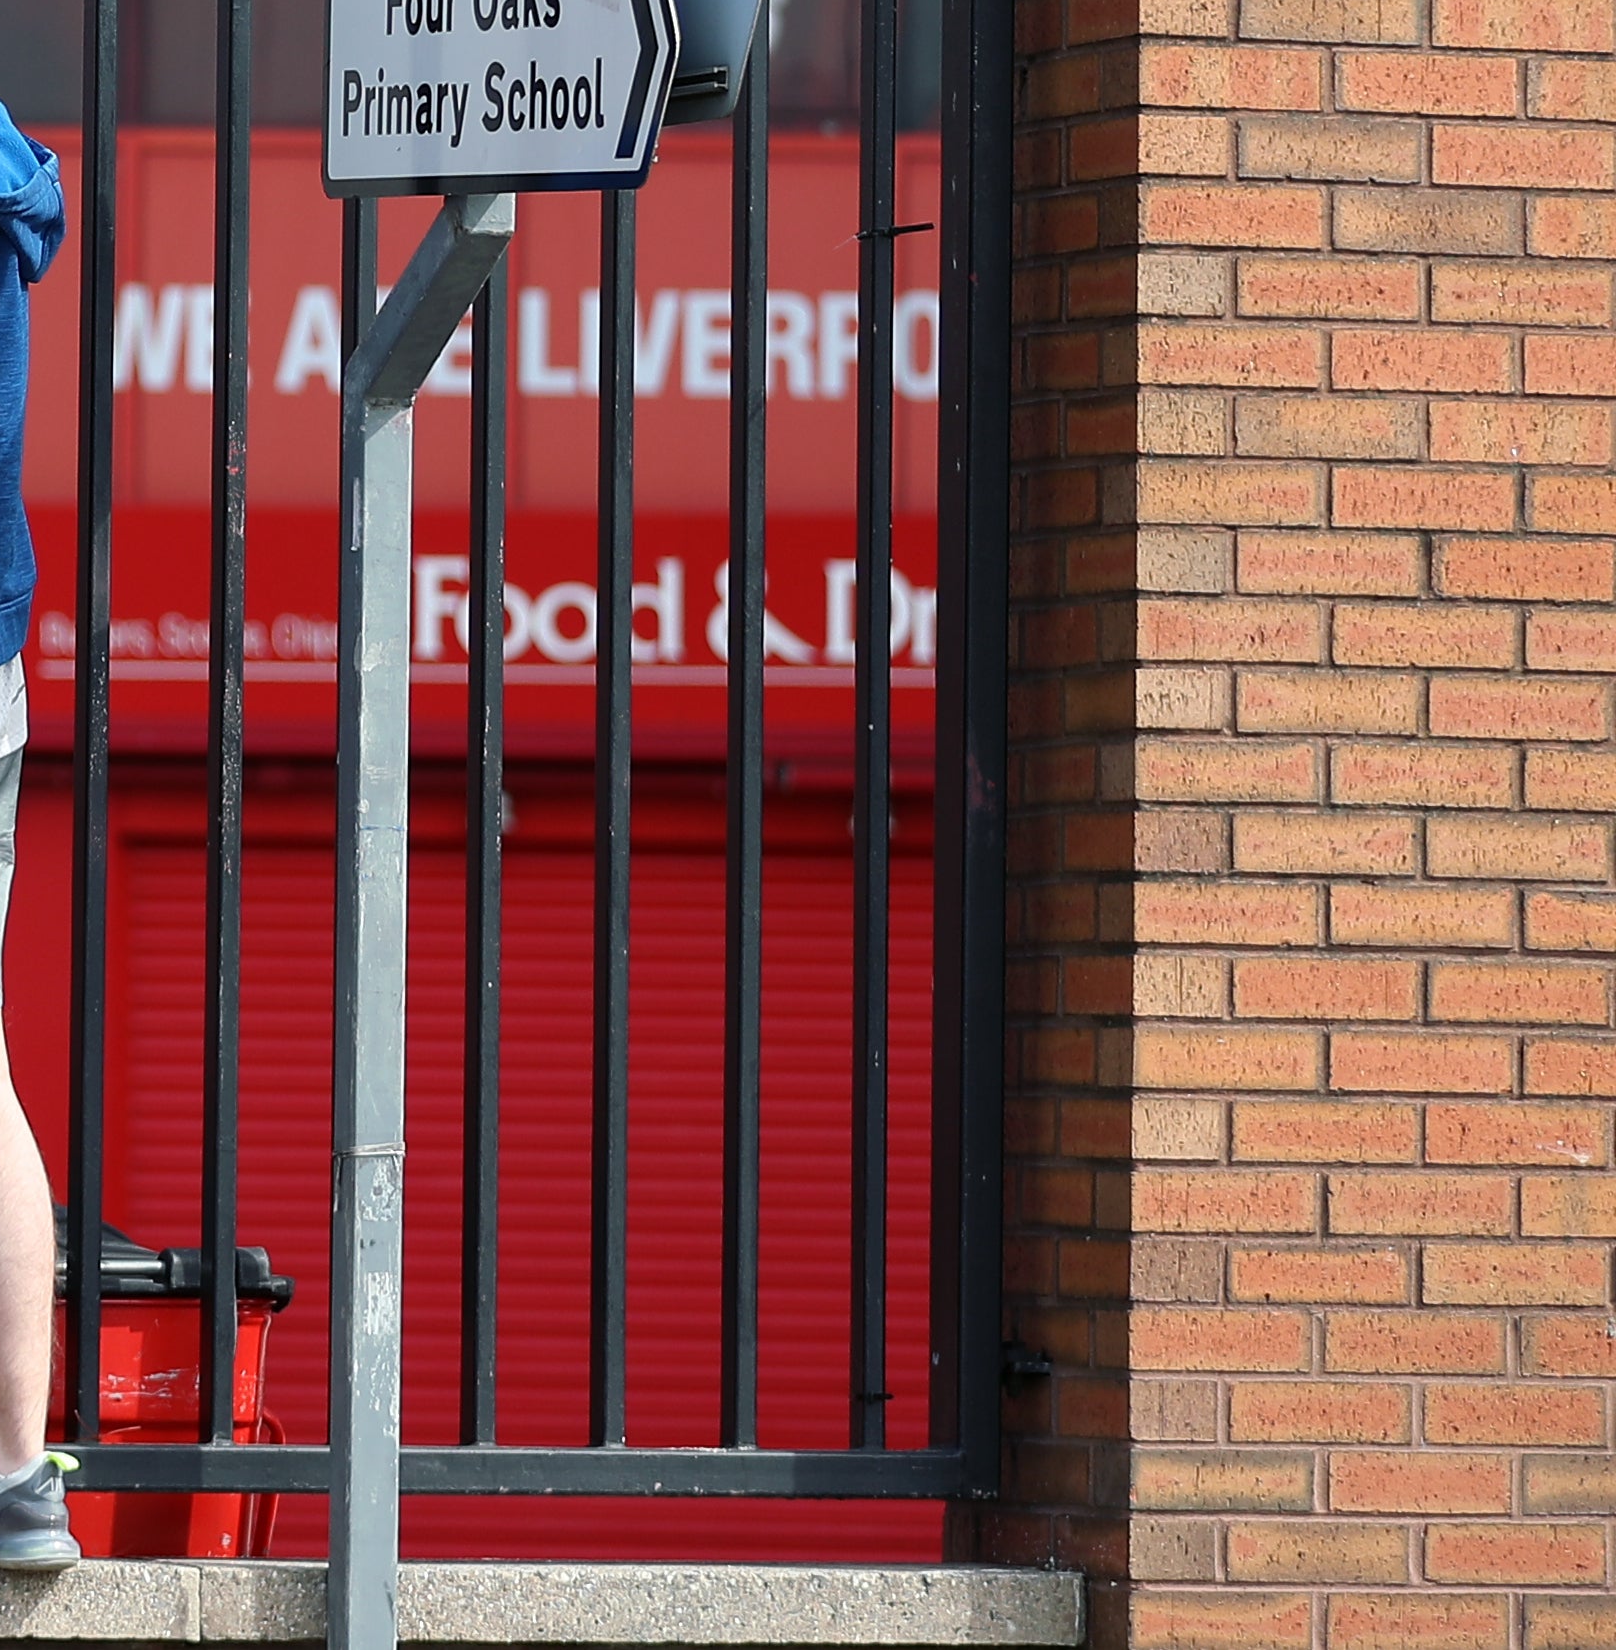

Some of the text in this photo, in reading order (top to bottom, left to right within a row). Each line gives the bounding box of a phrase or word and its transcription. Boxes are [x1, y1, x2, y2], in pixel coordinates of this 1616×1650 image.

[341, 56, 605, 148] Primary School
[413, 554, 686, 665] Food
